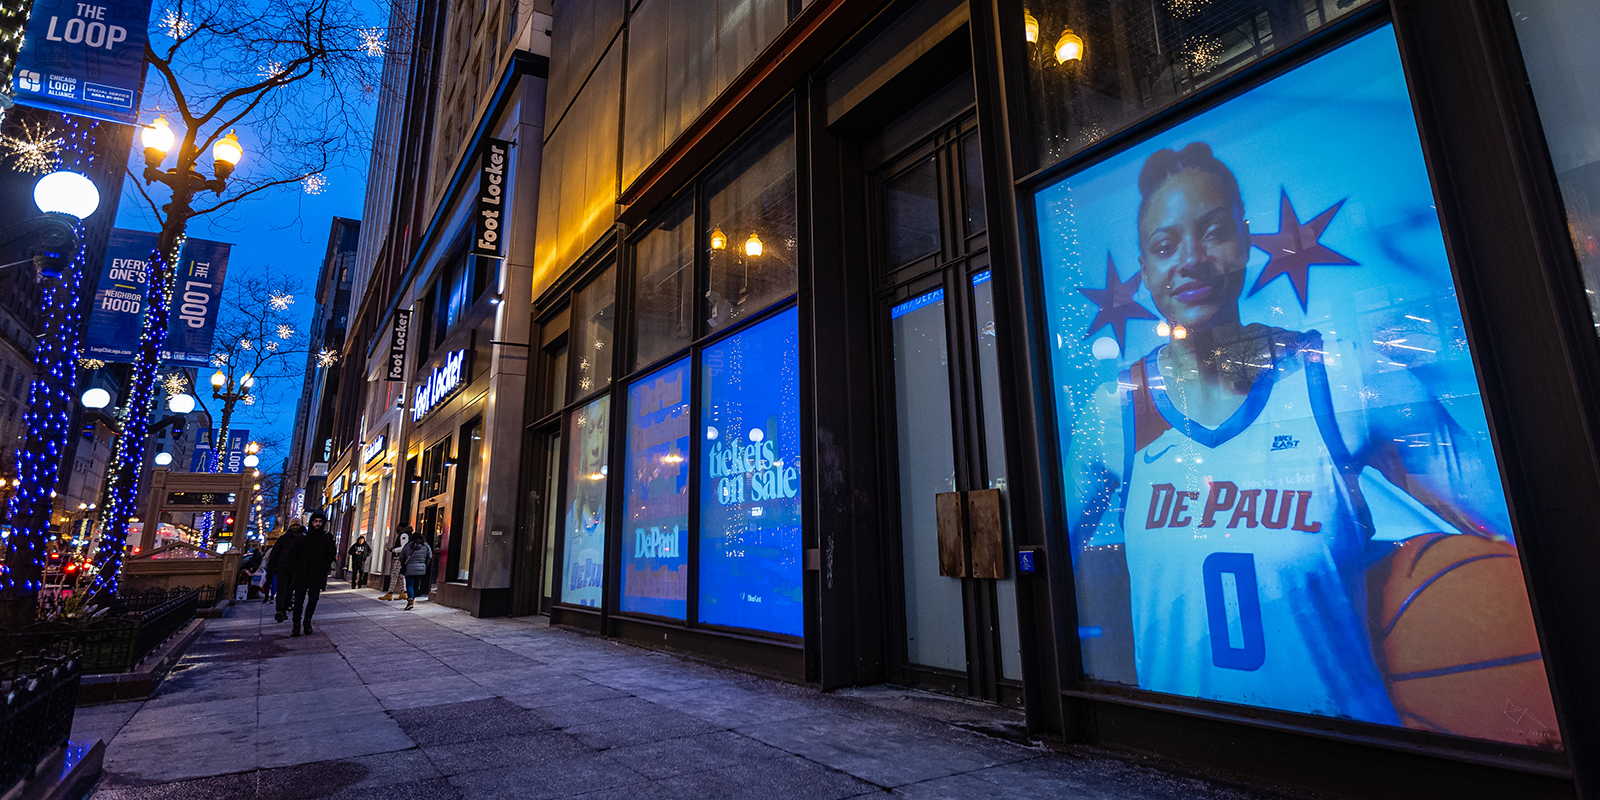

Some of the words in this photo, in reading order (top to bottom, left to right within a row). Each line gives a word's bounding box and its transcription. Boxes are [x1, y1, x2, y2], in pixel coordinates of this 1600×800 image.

[77, 3, 107, 21] THE
[46, 16, 127, 50] LOOP
[48, 81, 76, 92] LOOP
[49, 74, 77, 84] CHICAGO
[482, 145, 505, 205] Locker
[478, 210, 500, 251] Foot
[112, 258, 149, 271] EVERY
[194, 262, 210, 279] THE
[109, 268, 147, 284] ONE'S
[101, 297, 141, 314] HOOD
[105, 290, 141, 301] NEIGHBOR
[179, 281, 213, 329] LOOP
[393, 313, 408, 351] Locker
[389, 354, 404, 378] Foot
[1271, 440, 1300, 448] EAST
[228, 451, 242, 472] LOOP
[709, 437, 775, 479] tickets
[717, 475, 745, 505] on
[751, 457, 797, 502] sale
[634, 524, 679, 559] DePaul
[1202, 552, 1266, 672] 0
